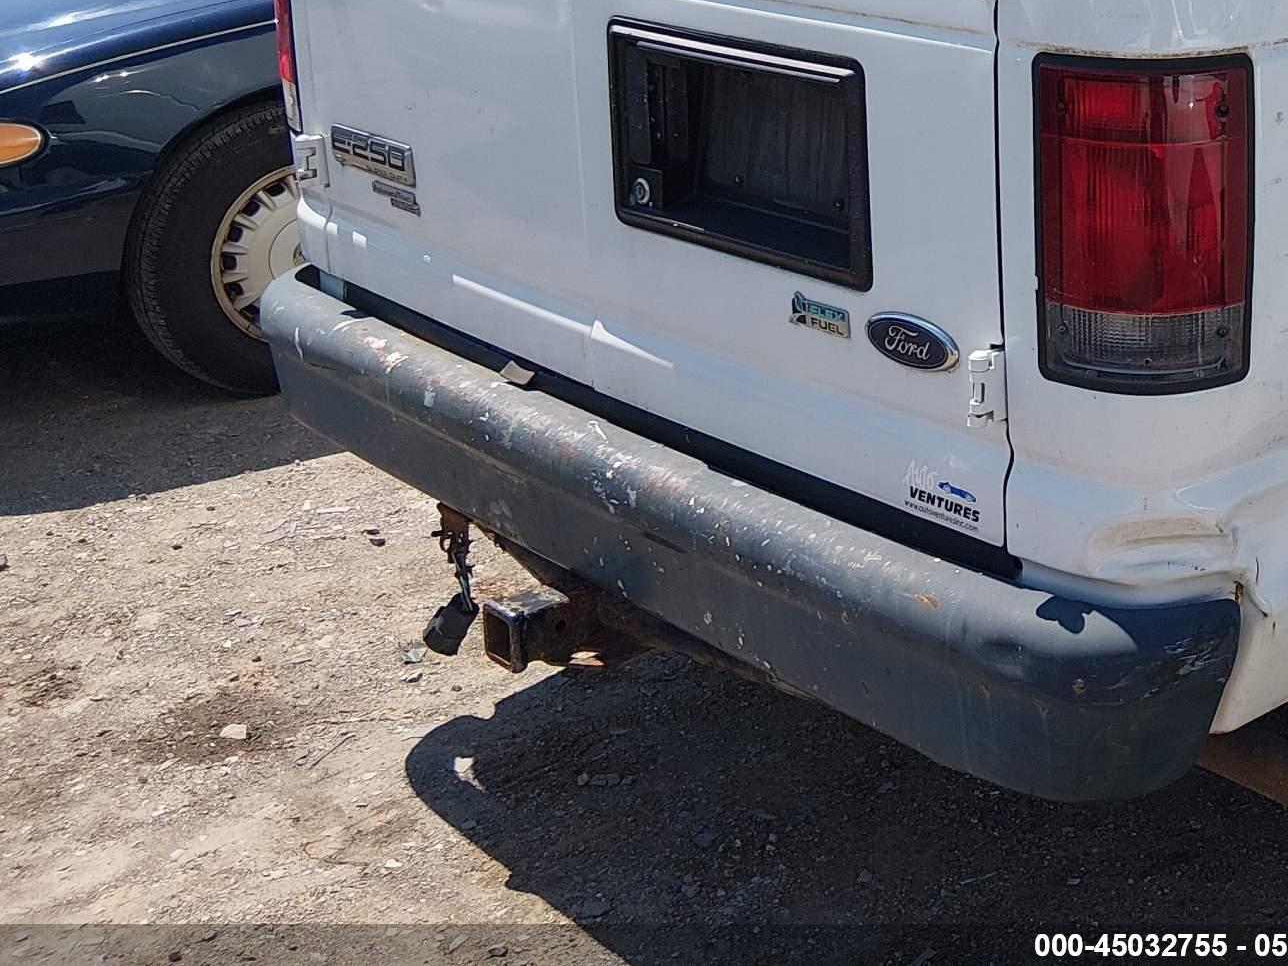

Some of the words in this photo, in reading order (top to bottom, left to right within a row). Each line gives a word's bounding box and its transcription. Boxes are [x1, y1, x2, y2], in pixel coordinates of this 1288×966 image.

[811, 317, 844, 336] FUEL
[885, 325, 930, 360] Ford
[909, 486, 981, 523] VENTURES
